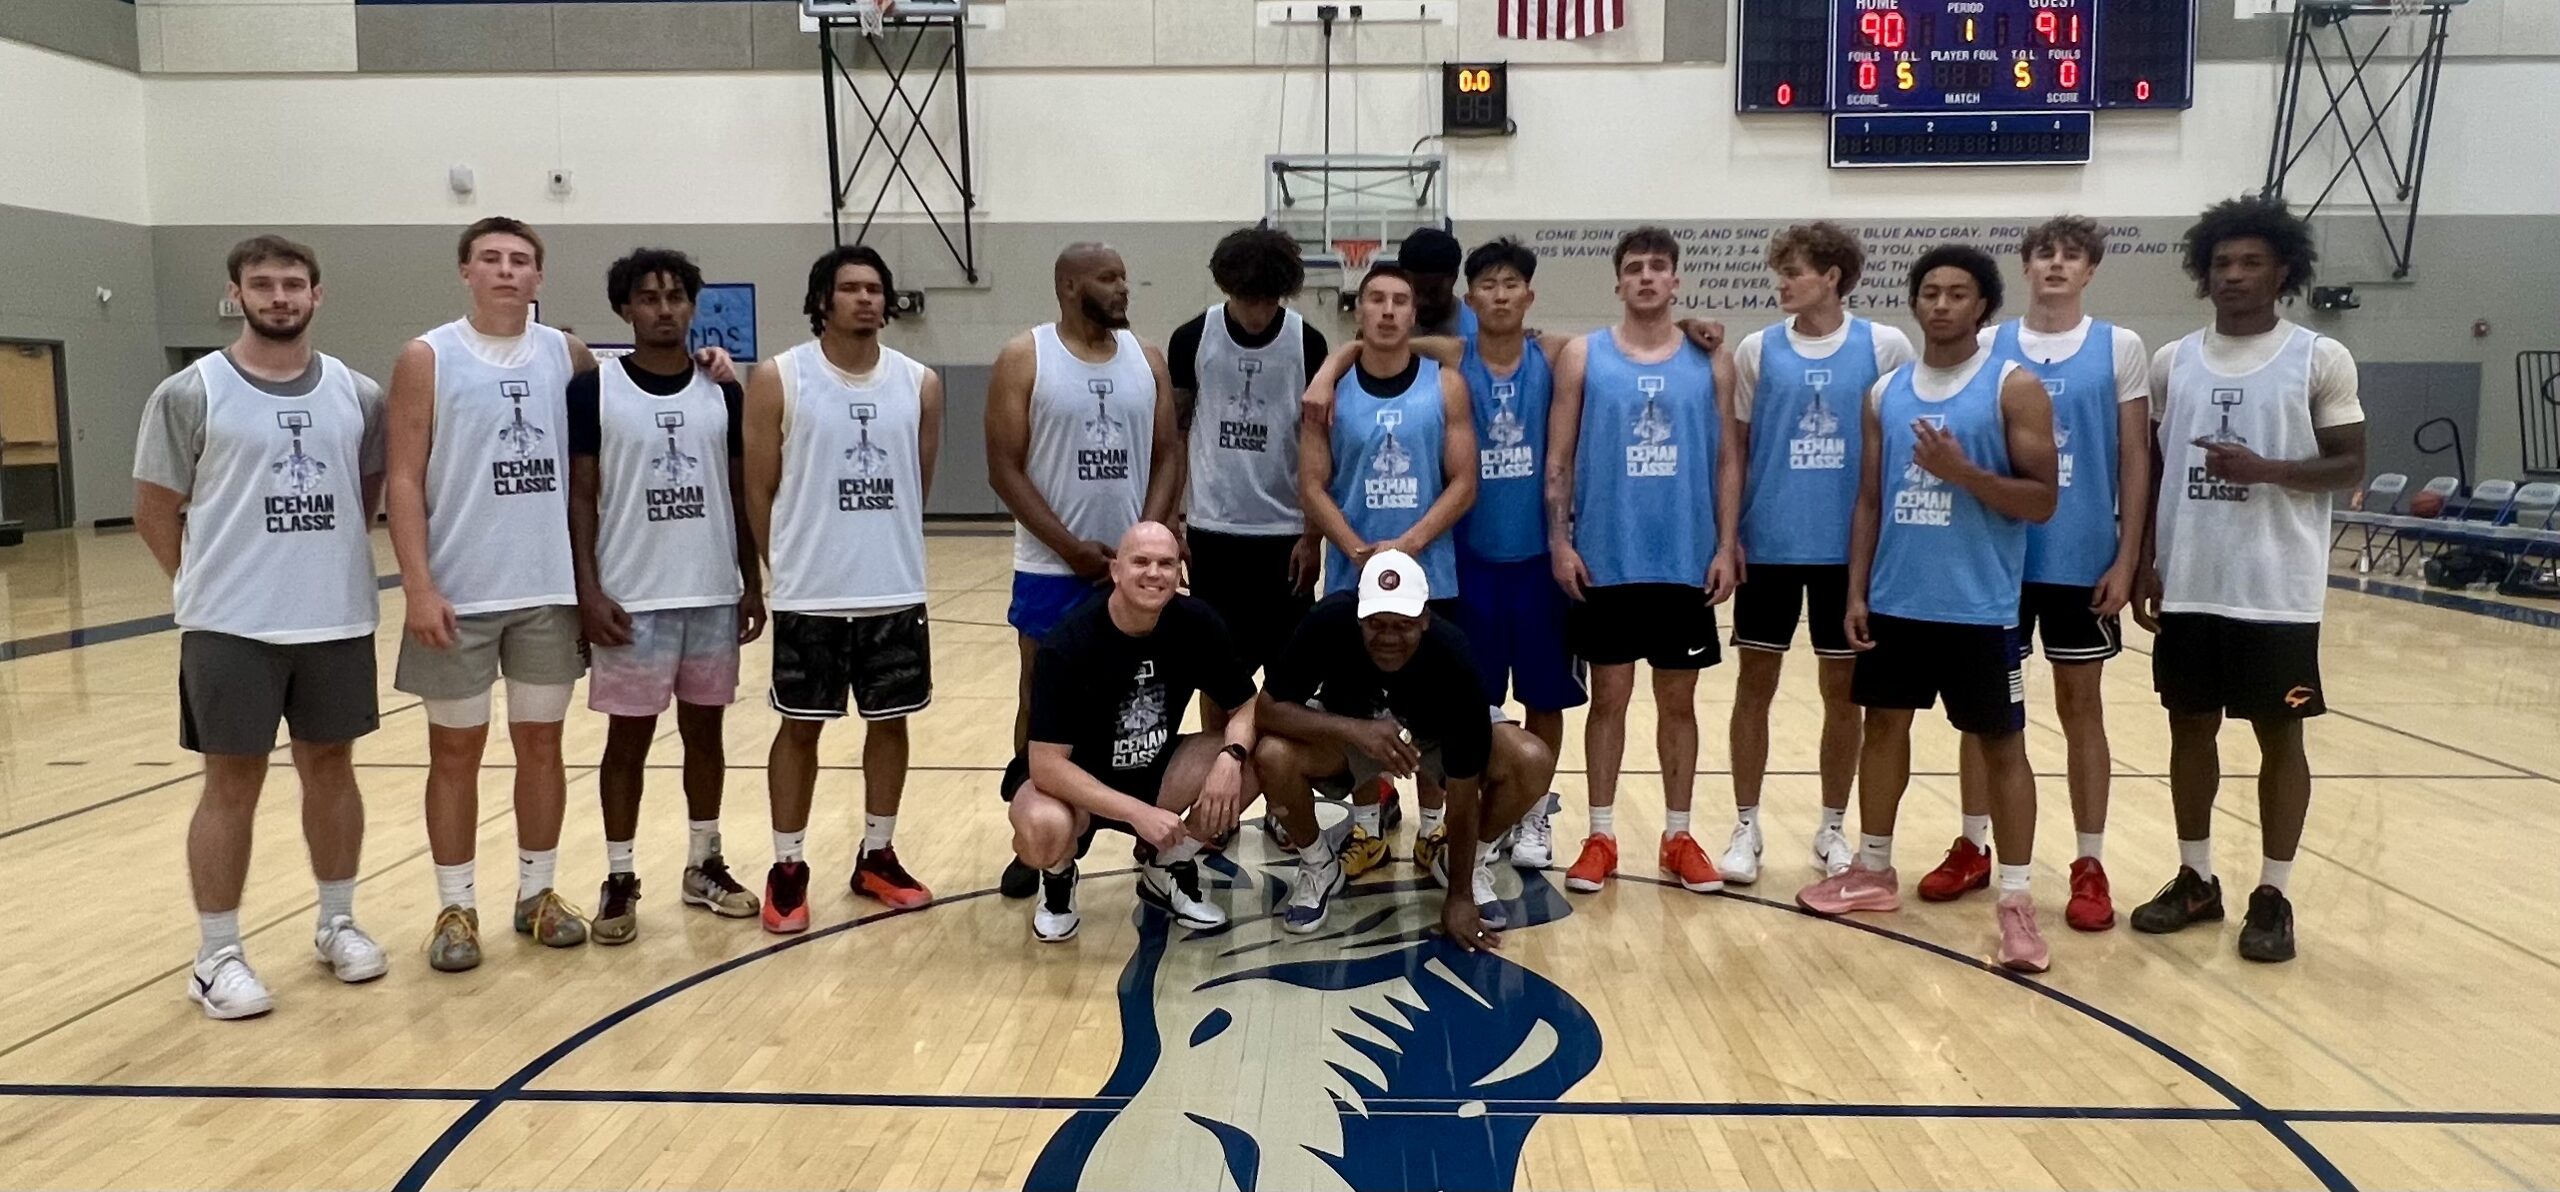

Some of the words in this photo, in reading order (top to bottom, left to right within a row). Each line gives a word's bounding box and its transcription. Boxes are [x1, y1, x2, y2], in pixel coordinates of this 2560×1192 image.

[1947, 2, 1983, 14] PERIOD
[1861, 12, 1904, 47] 90
[1965, 18, 1974, 42] 1
[2035, 11, 2078, 44] 91
[1848, 51, 1880, 62] FOULS
[1931, 50, 1969, 61] PLAYER
[1973, 50, 1999, 61] FOUL
[2048, 49, 2081, 60] FOULS
[1459, 70, 1491, 92] 0.0
[1859, 62, 1877, 90] 0
[2060, 60, 2077, 88] 0
[1777, 84, 1791, 105] 0
[1945, 93, 1980, 104] MATCH
[2047, 92, 2079, 103] SCORE
[2136, 81, 2149, 100] 0
[1847, 94, 1879, 105] SCORE
[1864, 121, 1870, 133] 1
[1927, 121, 1934, 133] 2
[1991, 120, 1998, 131] 3
[1536, 230, 1576, 241] COME
[1581, 230, 1613, 241] JOIN
[1700, 228, 1731, 240] AND
[1735, 228, 1769, 240] SING
[1863, 228, 1899, 239] BLUE
[1904, 228, 1936, 239] AND
[1563, 246, 1616, 257] WAVIN
[2135, 243, 2167, 254] AND
[1683, 262, 1720, 272] WITH
[1699, 278, 1728, 289] FOR
[1861, 278, 1909, 288] PULLM
[1219, 421, 1268, 438] ICEMAN
[1219, 436, 1267, 452] CLASSIC
[1790, 438, 1845, 455] ICEMAN
[1078, 449, 1128, 466] ICEMAN
[1481, 446, 1532, 465] ICEMAN
[1626, 445, 1678, 461] ICEMAN
[493, 458, 555, 479] ICEMAN
[1627, 461, 1678, 476] CLASSIC
[1790, 455, 1845, 469] CLASSIC
[1078, 466, 1128, 480] CLASSIC
[1482, 464, 1533, 480] CLASSIC
[494, 477, 556, 495] CLASSIC
[838, 478, 893, 494] ICEMAN
[1365, 477, 1417, 495] ICEMAN
[2188, 485, 2249, 502] CLASSIC
[264, 494, 335, 515] ICEMAN
[646, 486, 704, 506] ICEMAN
[839, 496, 894, 511] CLASSIC
[1366, 495, 1418, 509] CLASSIC
[1895, 491, 1953, 510] ICEMAN
[647, 504, 705, 522] CLASSIC
[1895, 509, 1951, 527] CLASSIC
[266, 514, 335, 533] CLASSIC
[1114, 729, 1167, 755] ICEMAN
[1112, 749, 1156, 767] CLASS
